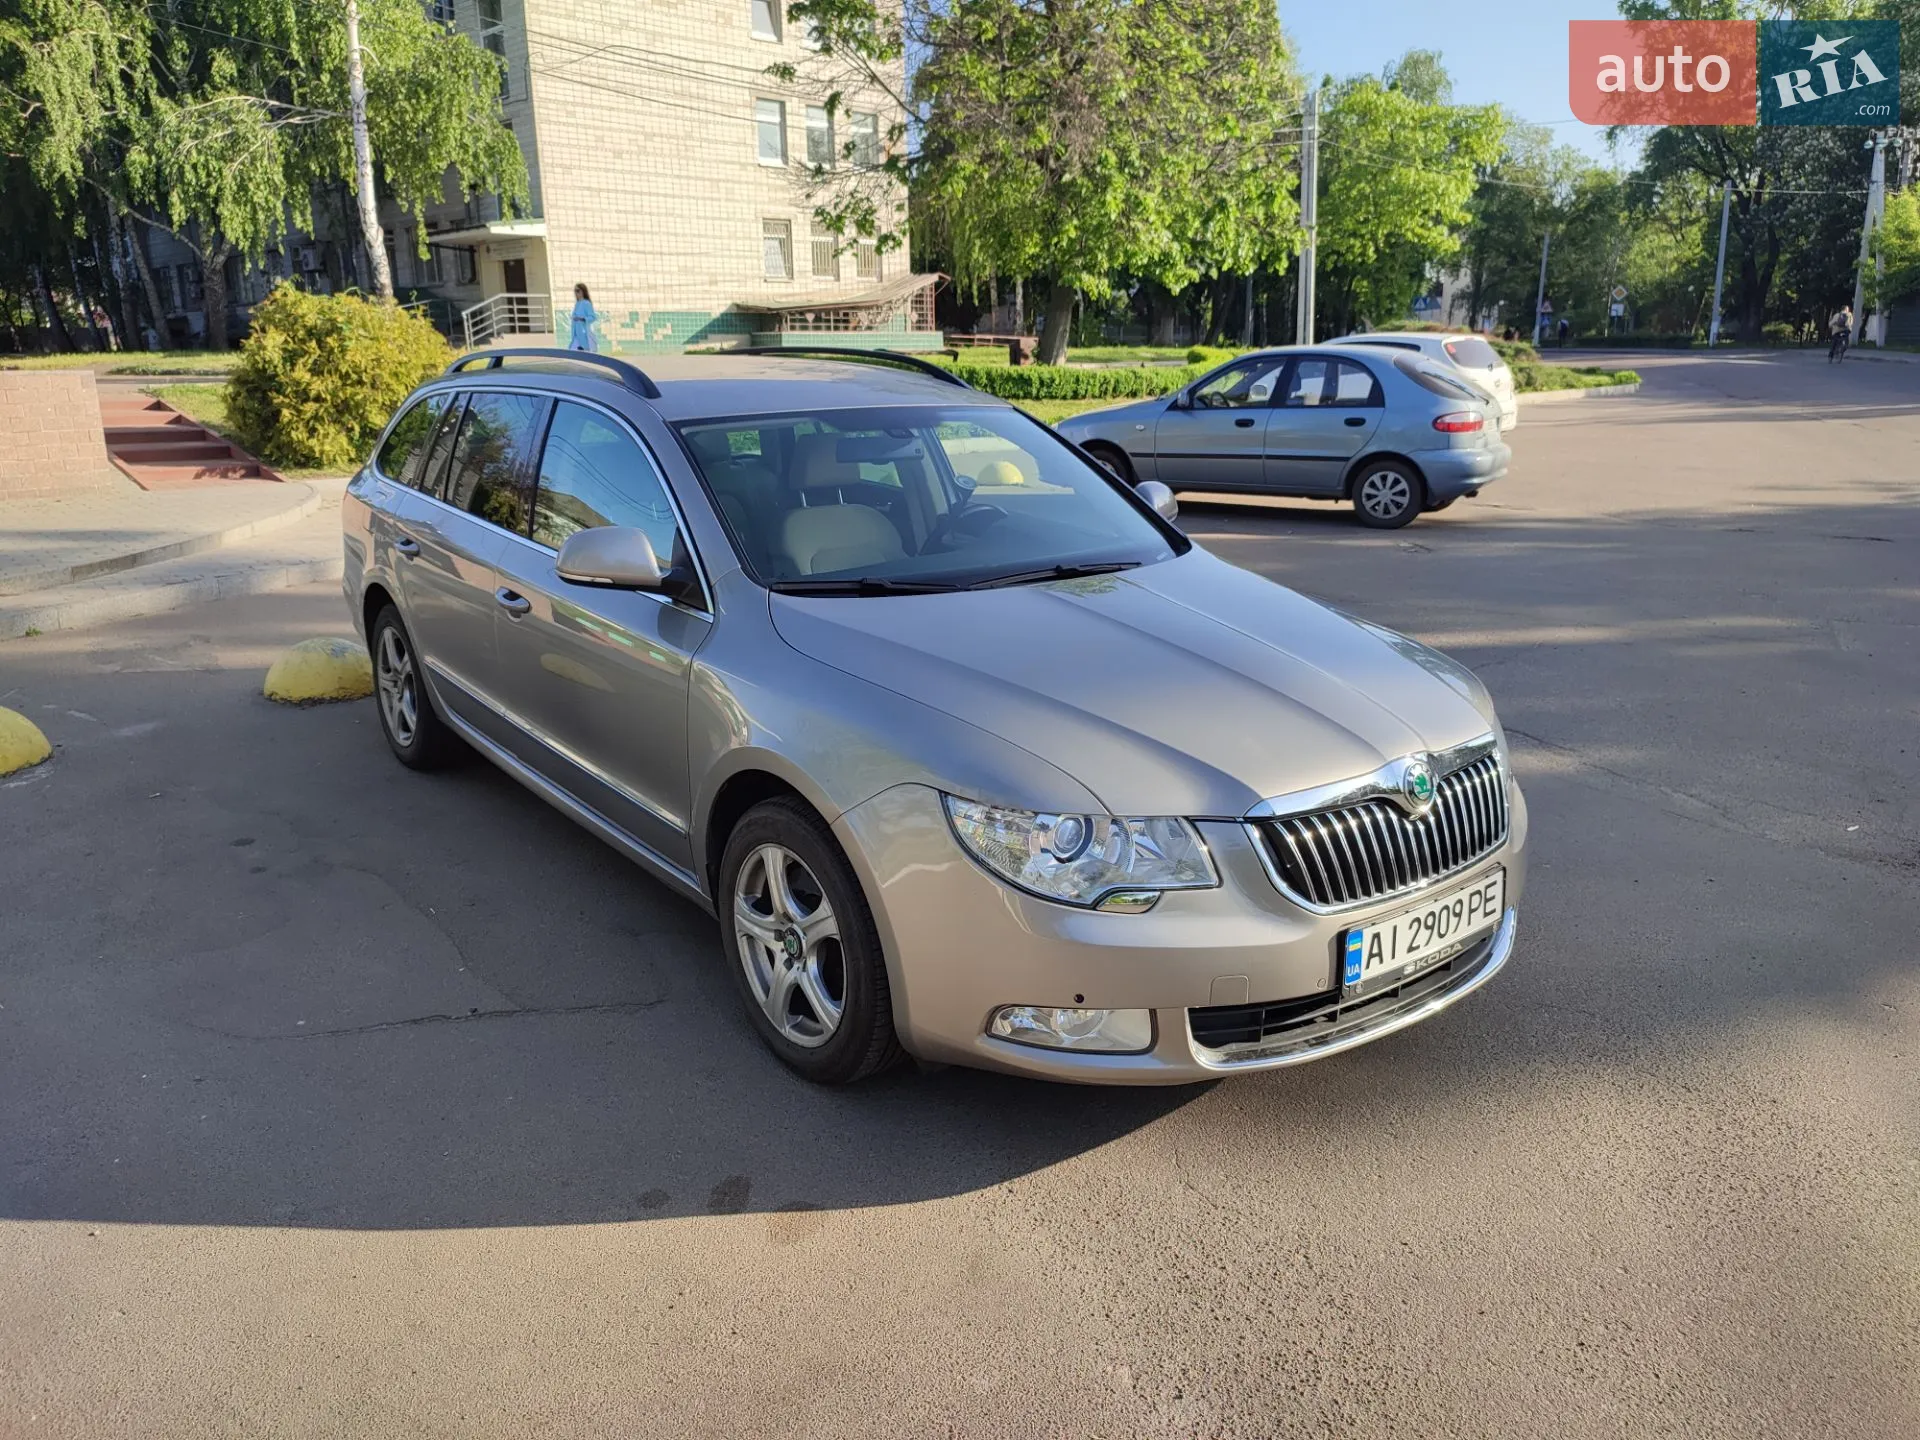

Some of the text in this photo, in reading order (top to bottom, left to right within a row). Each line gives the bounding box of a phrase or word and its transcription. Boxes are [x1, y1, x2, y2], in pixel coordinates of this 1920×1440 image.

[1365, 880, 1498, 970] AI 2909 PE
[1347, 965, 1360, 977] UA
